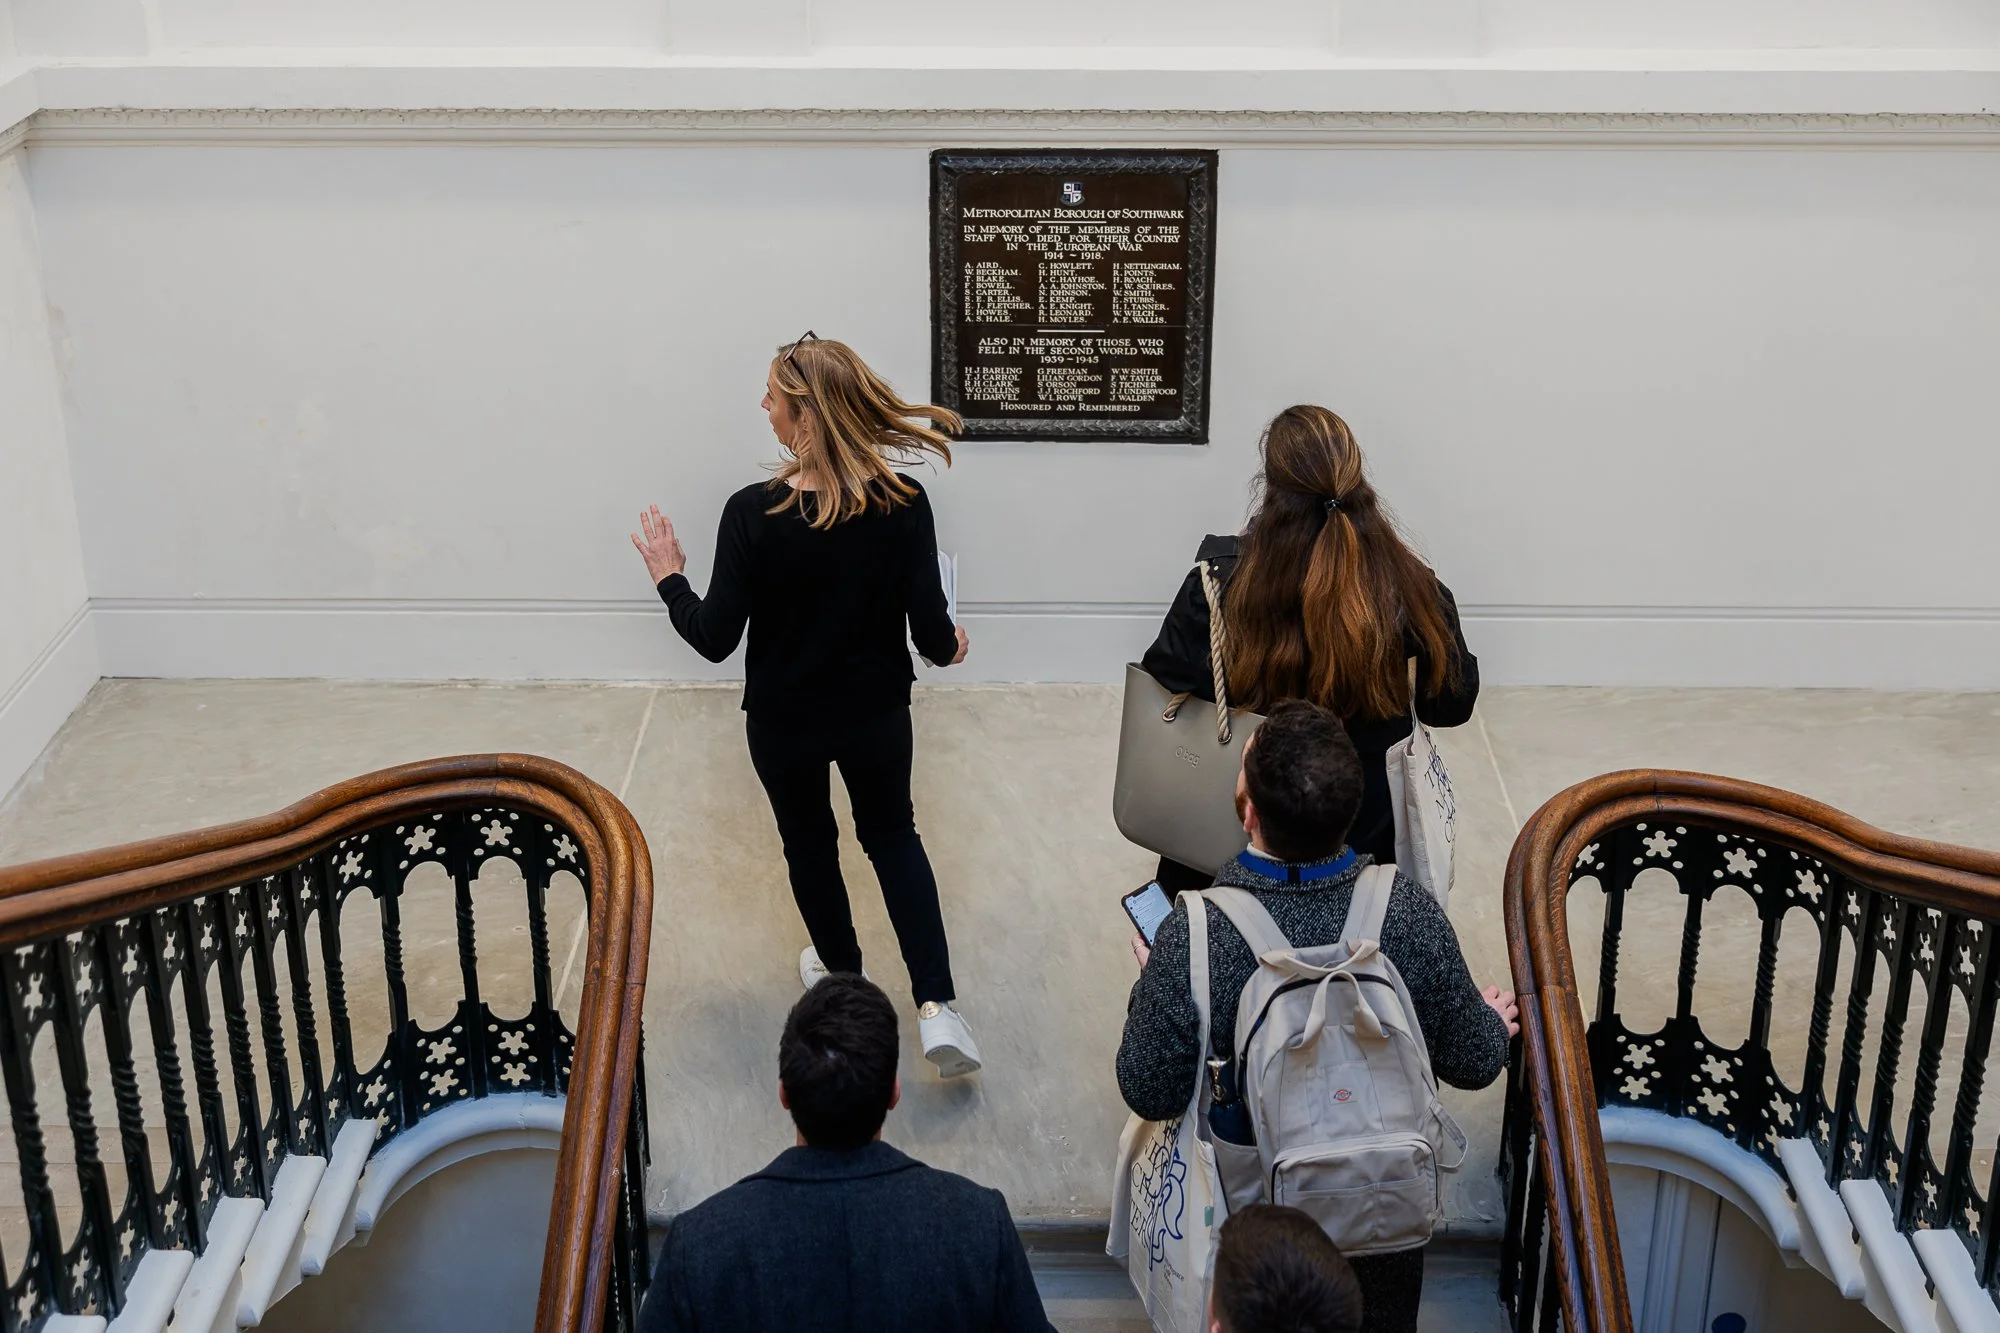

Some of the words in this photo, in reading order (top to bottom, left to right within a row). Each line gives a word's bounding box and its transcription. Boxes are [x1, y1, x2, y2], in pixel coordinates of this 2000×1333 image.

[963, 208, 1050, 218] METROPOLITAN
[1054, 208, 1106, 219] BOROUGH
[1107, 209, 1121, 219] OF
[1122, 208, 1184, 219] SOUTHWARK
[964, 226, 975, 234] IN
[979, 226, 1024, 234] MEMORY
[1028, 226, 1043, 234] OF
[1048, 226, 1070, 234] THE
[1078, 226, 1130, 234] MEMBERS
[1137, 226, 1151, 234] OF
[1158, 226, 1179, 234] THE
[964, 234, 996, 242] STAFF
[1003, 234, 1029, 242] WHO
[1037, 234, 1061, 242] DIED
[1069, 234, 1090, 242] FOR
[1097, 234, 1129, 242] THEIR
[1134, 234, 1181, 243] COUNTRY
[1006, 243, 1018, 251] IN
[1026, 243, 1048, 251] THE
[1055, 242, 1110, 251] EUROPEAN
[1118, 243, 1143, 251] WAR
[1044, 252, 1064, 260] 1914
[1081, 252, 1104, 260] 1918.
[979, 338, 1008, 346] ALSO
[1013, 338, 1025, 346] IN
[1030, 338, 1076, 346] MEMORY
[1080, 338, 1093, 346] OF
[1096, 338, 1131, 346] THOSE
[1137, 339, 1164, 347] WHO
[978, 347, 1005, 355] FELL
[1009, 347, 1020, 355] IN
[1024, 347, 1045, 355] THE
[1050, 347, 1094, 355] SECOND
[1099, 347, 1138, 355] WORLD
[1141, 348, 1164, 356] WAR
[1040, 356, 1064, 364] 1939
[1076, 356, 1099, 364] 1945
[1000, 401, 1052, 411] HONOURED
[1078, 402, 1141, 412] REMEMBERED
